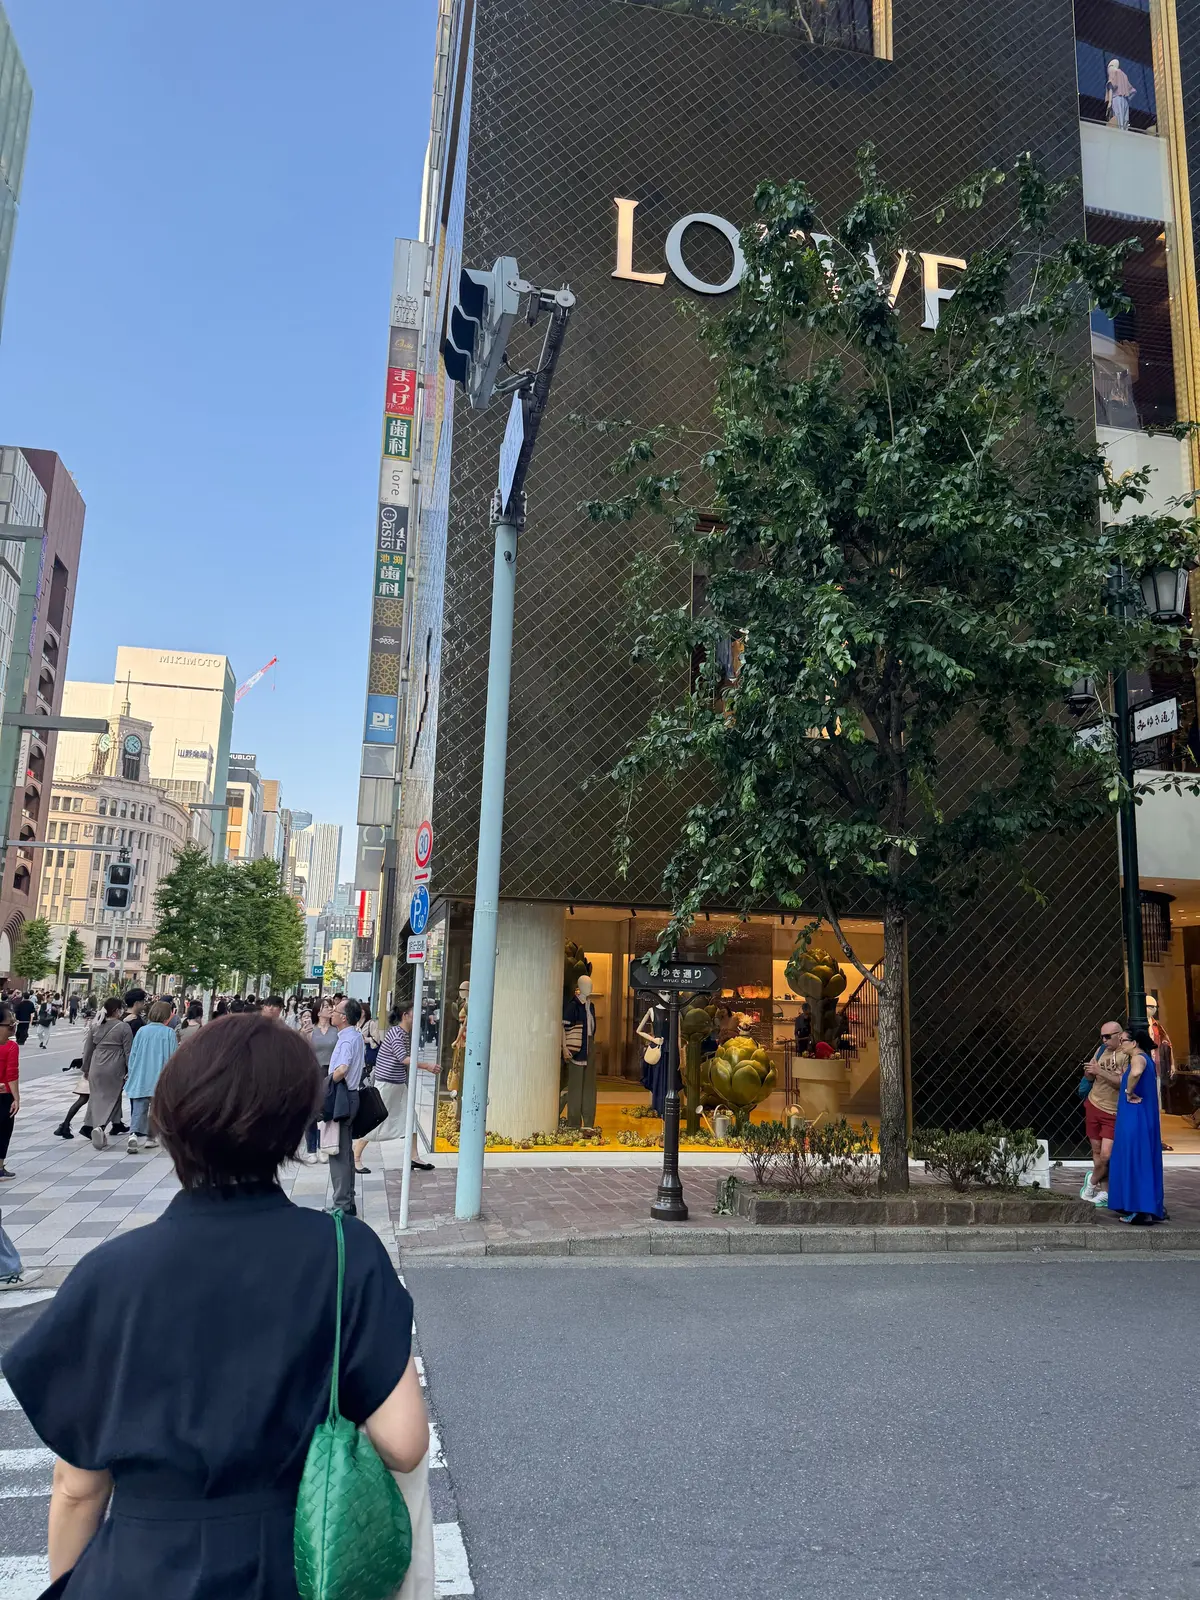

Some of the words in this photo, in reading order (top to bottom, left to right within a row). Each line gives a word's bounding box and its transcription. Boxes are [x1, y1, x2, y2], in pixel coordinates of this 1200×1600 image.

[392, 369, 411, 406] まつげ
[388, 419, 409, 456] 歯科
[390, 469, 404, 496] lore
[380, 507, 398, 549] Oasis
[396, 527, 406, 551] 4F
[378, 565, 402, 597] 歯科
[159, 655, 222, 668] MIKIMOTO
[418, 834, 429, 855] 30
[413, 899, 422, 929] P
